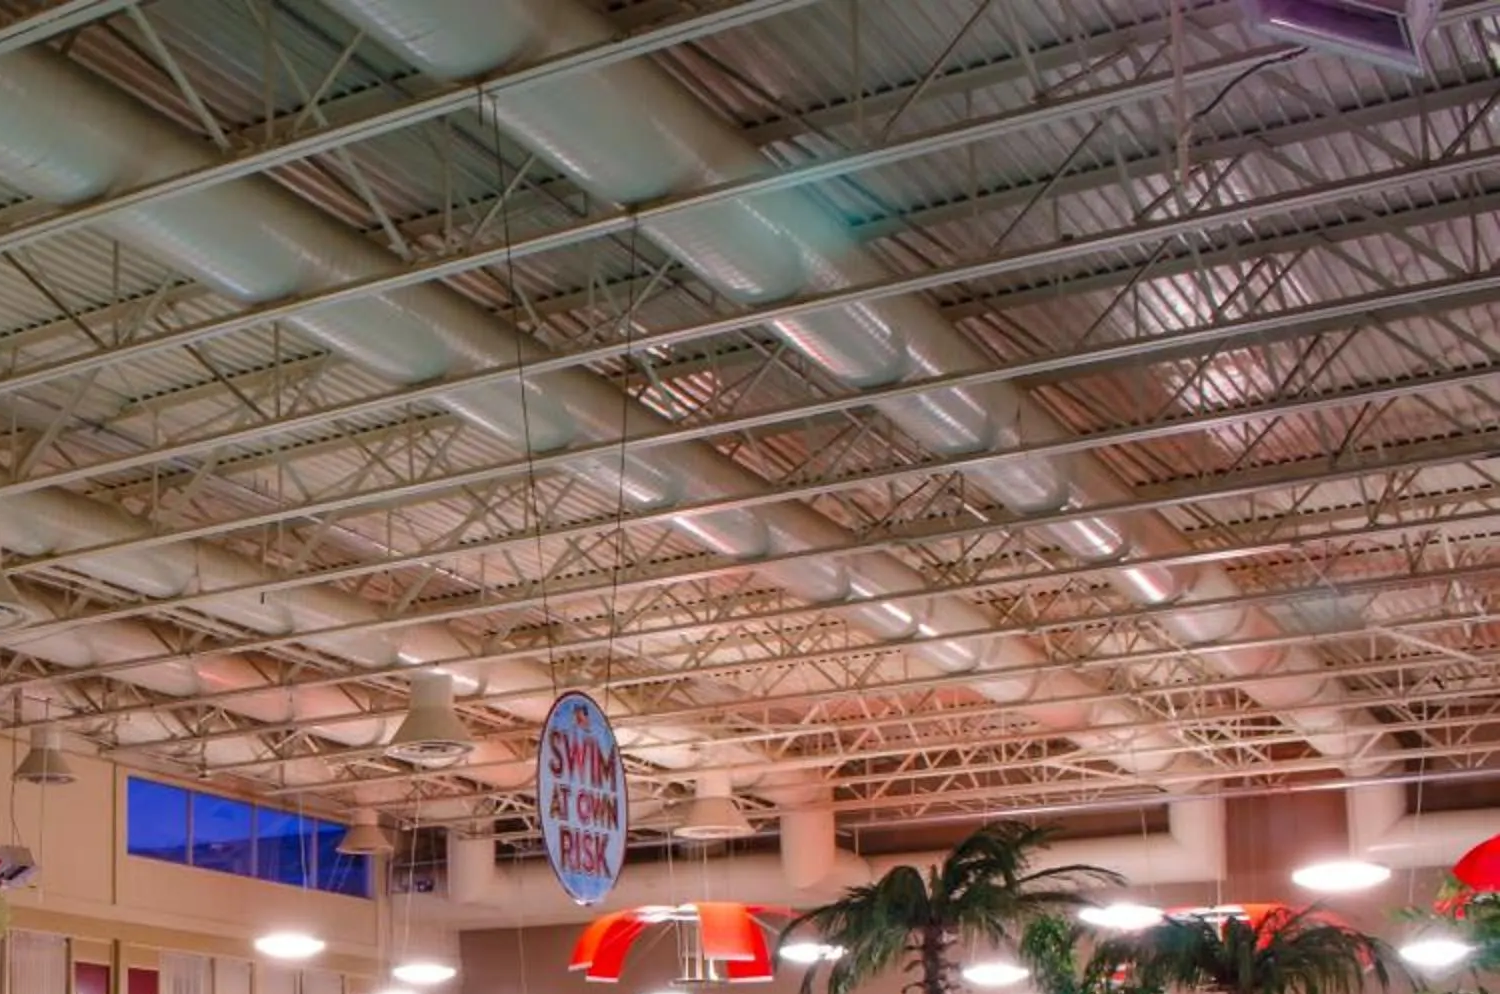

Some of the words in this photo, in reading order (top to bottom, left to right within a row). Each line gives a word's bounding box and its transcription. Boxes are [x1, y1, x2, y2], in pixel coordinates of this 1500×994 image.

[548, 731, 617, 793] SWIM
[550, 783, 571, 822] AT
[576, 790, 619, 831] OWN
[560, 826, 612, 878] RISK
